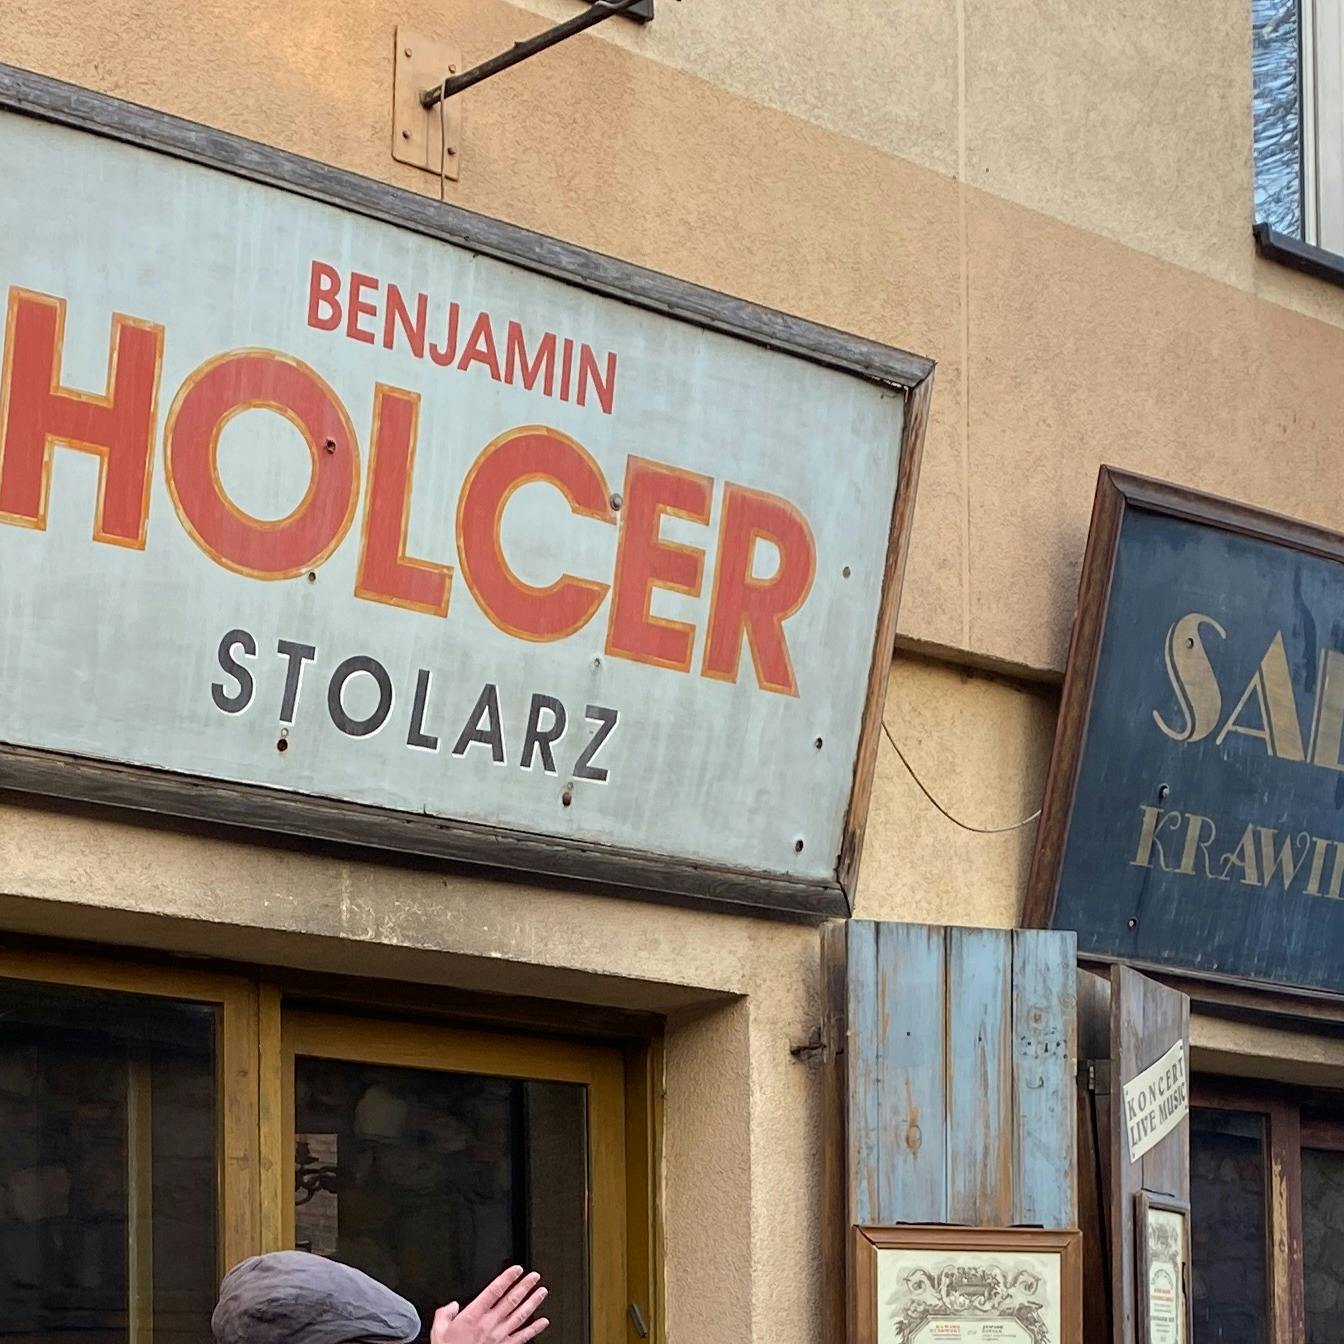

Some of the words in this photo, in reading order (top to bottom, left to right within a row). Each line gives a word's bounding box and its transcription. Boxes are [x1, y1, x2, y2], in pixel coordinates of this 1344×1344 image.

[307, 260, 619, 414] BENJAMIN
[211, 628, 621, 783] STOLARZ
[1127, 1057, 1183, 1121] KONCERT
[1130, 1109, 1157, 1148] LIVE
[1159, 1081, 1186, 1124] MUSIC
